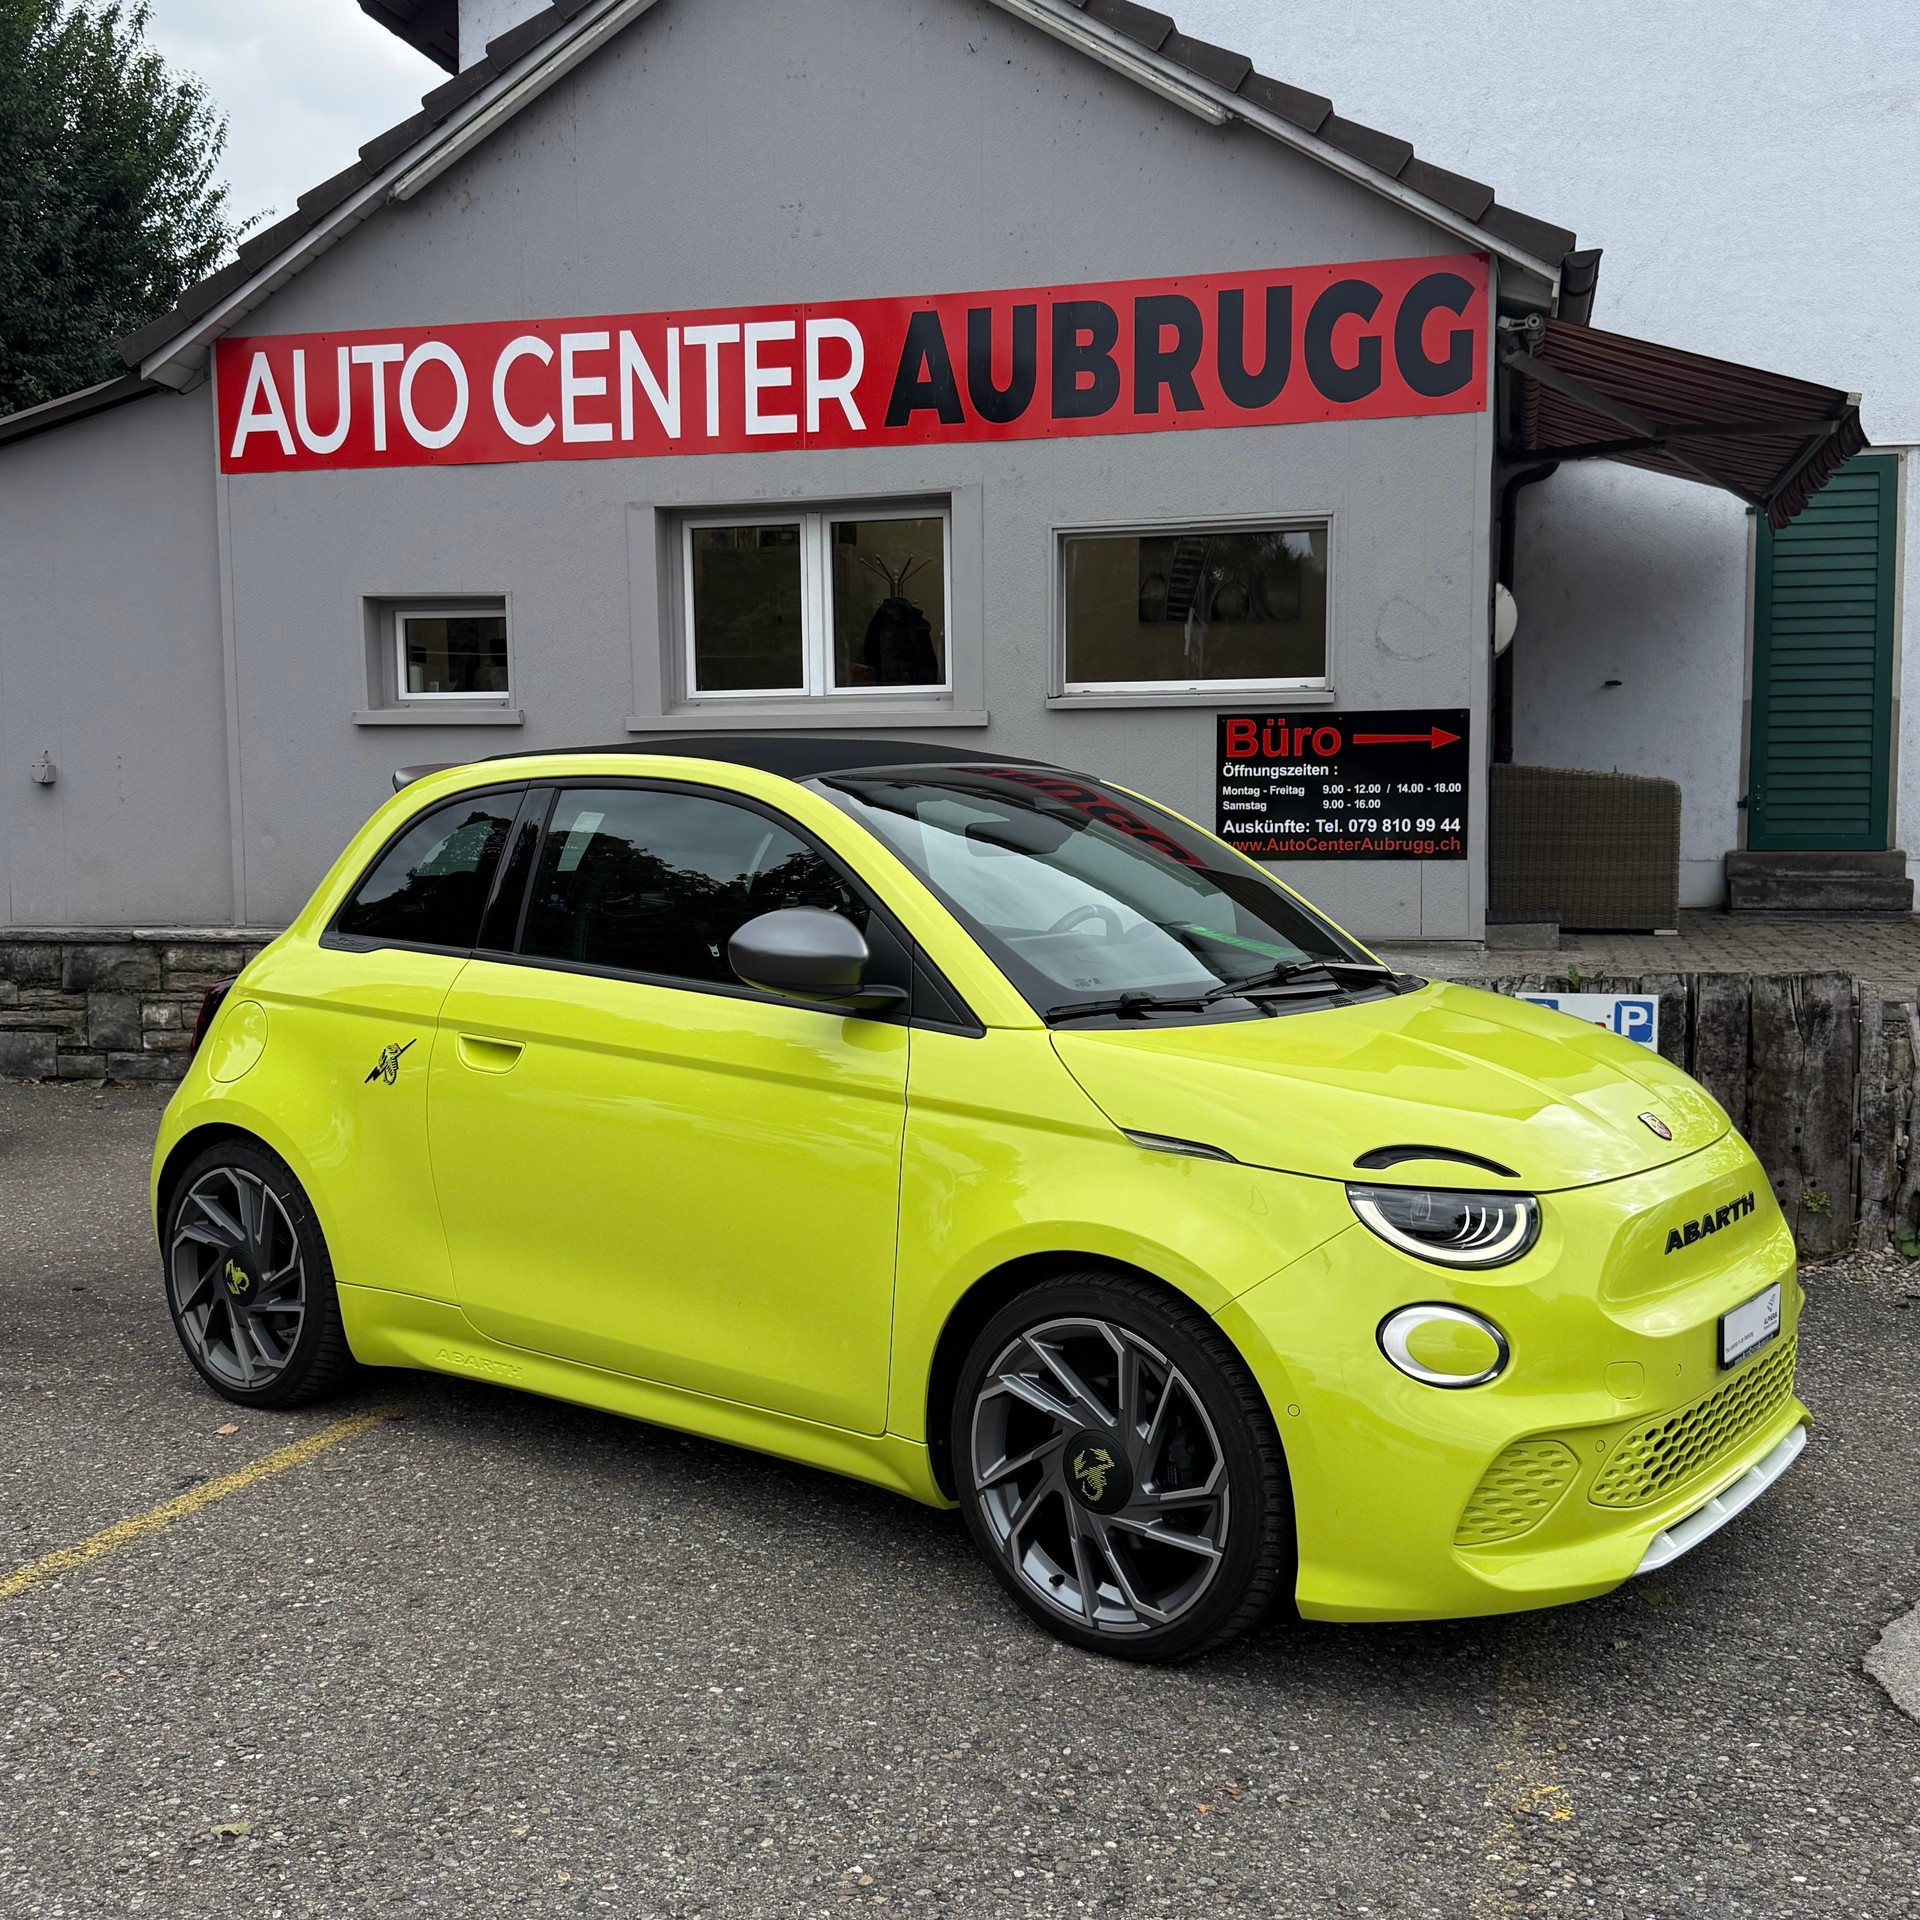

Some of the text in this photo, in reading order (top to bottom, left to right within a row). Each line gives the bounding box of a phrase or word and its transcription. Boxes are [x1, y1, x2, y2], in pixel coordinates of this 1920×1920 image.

[230, 272, 1475, 457] AUTO CENTER AUBRUGG
[1226, 718, 1342, 758] Büro
[1222, 762, 1329, 779] Öffnungszeiten
[1222, 786, 1260, 797] Montag
[1269, 785, 1305, 796] Freitag
[1322, 784, 1344, 794] 9.00
[1354, 783, 1381, 794] 12.00
[1396, 783, 1424, 793] 14.00
[1434, 782, 1462, 793] 18.00
[1222, 801, 1267, 812] Samstag
[1322, 799, 1344, 809] 9.00
[1354, 799, 1381, 809] 16.00
[1222, 817, 1461, 834] Auskünfte: Tel. 079 810 99 44
[1620, 1005, 1648, 1037] P
[1665, 1191, 1755, 1255] ABARTH
[436, 1348, 522, 1379] ABARTH
